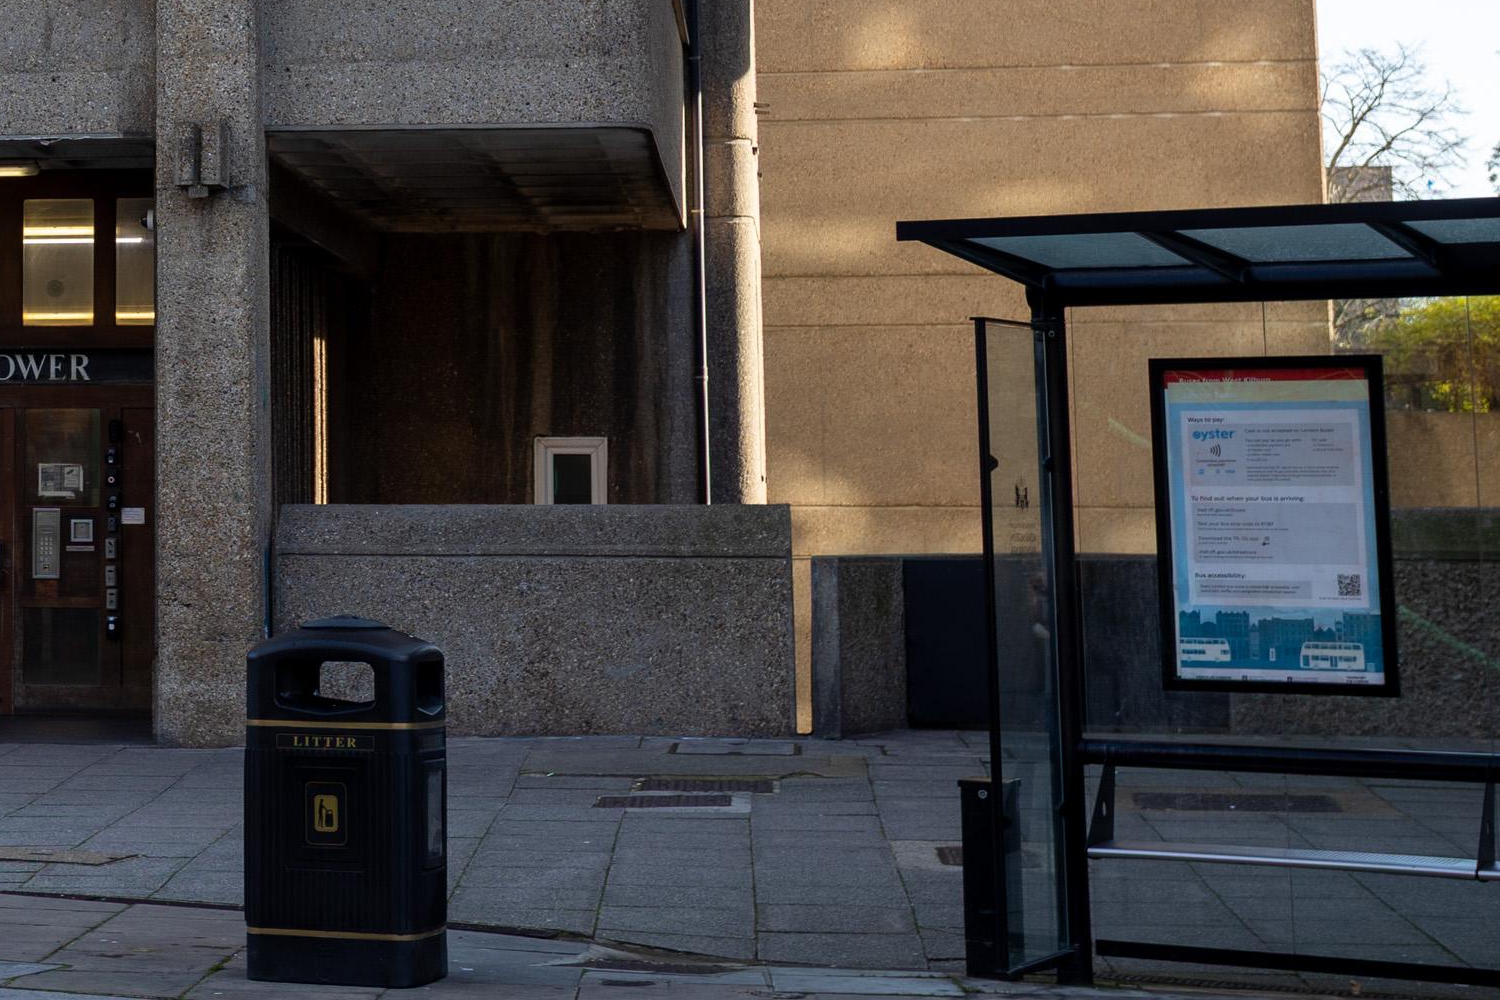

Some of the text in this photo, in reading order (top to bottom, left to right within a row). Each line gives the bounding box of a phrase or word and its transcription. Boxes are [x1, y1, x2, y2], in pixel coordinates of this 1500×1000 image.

[1192, 428, 1236, 441] oyster
[1245, 495, 1259, 503] your
[293, 736, 357, 748] LITTER
